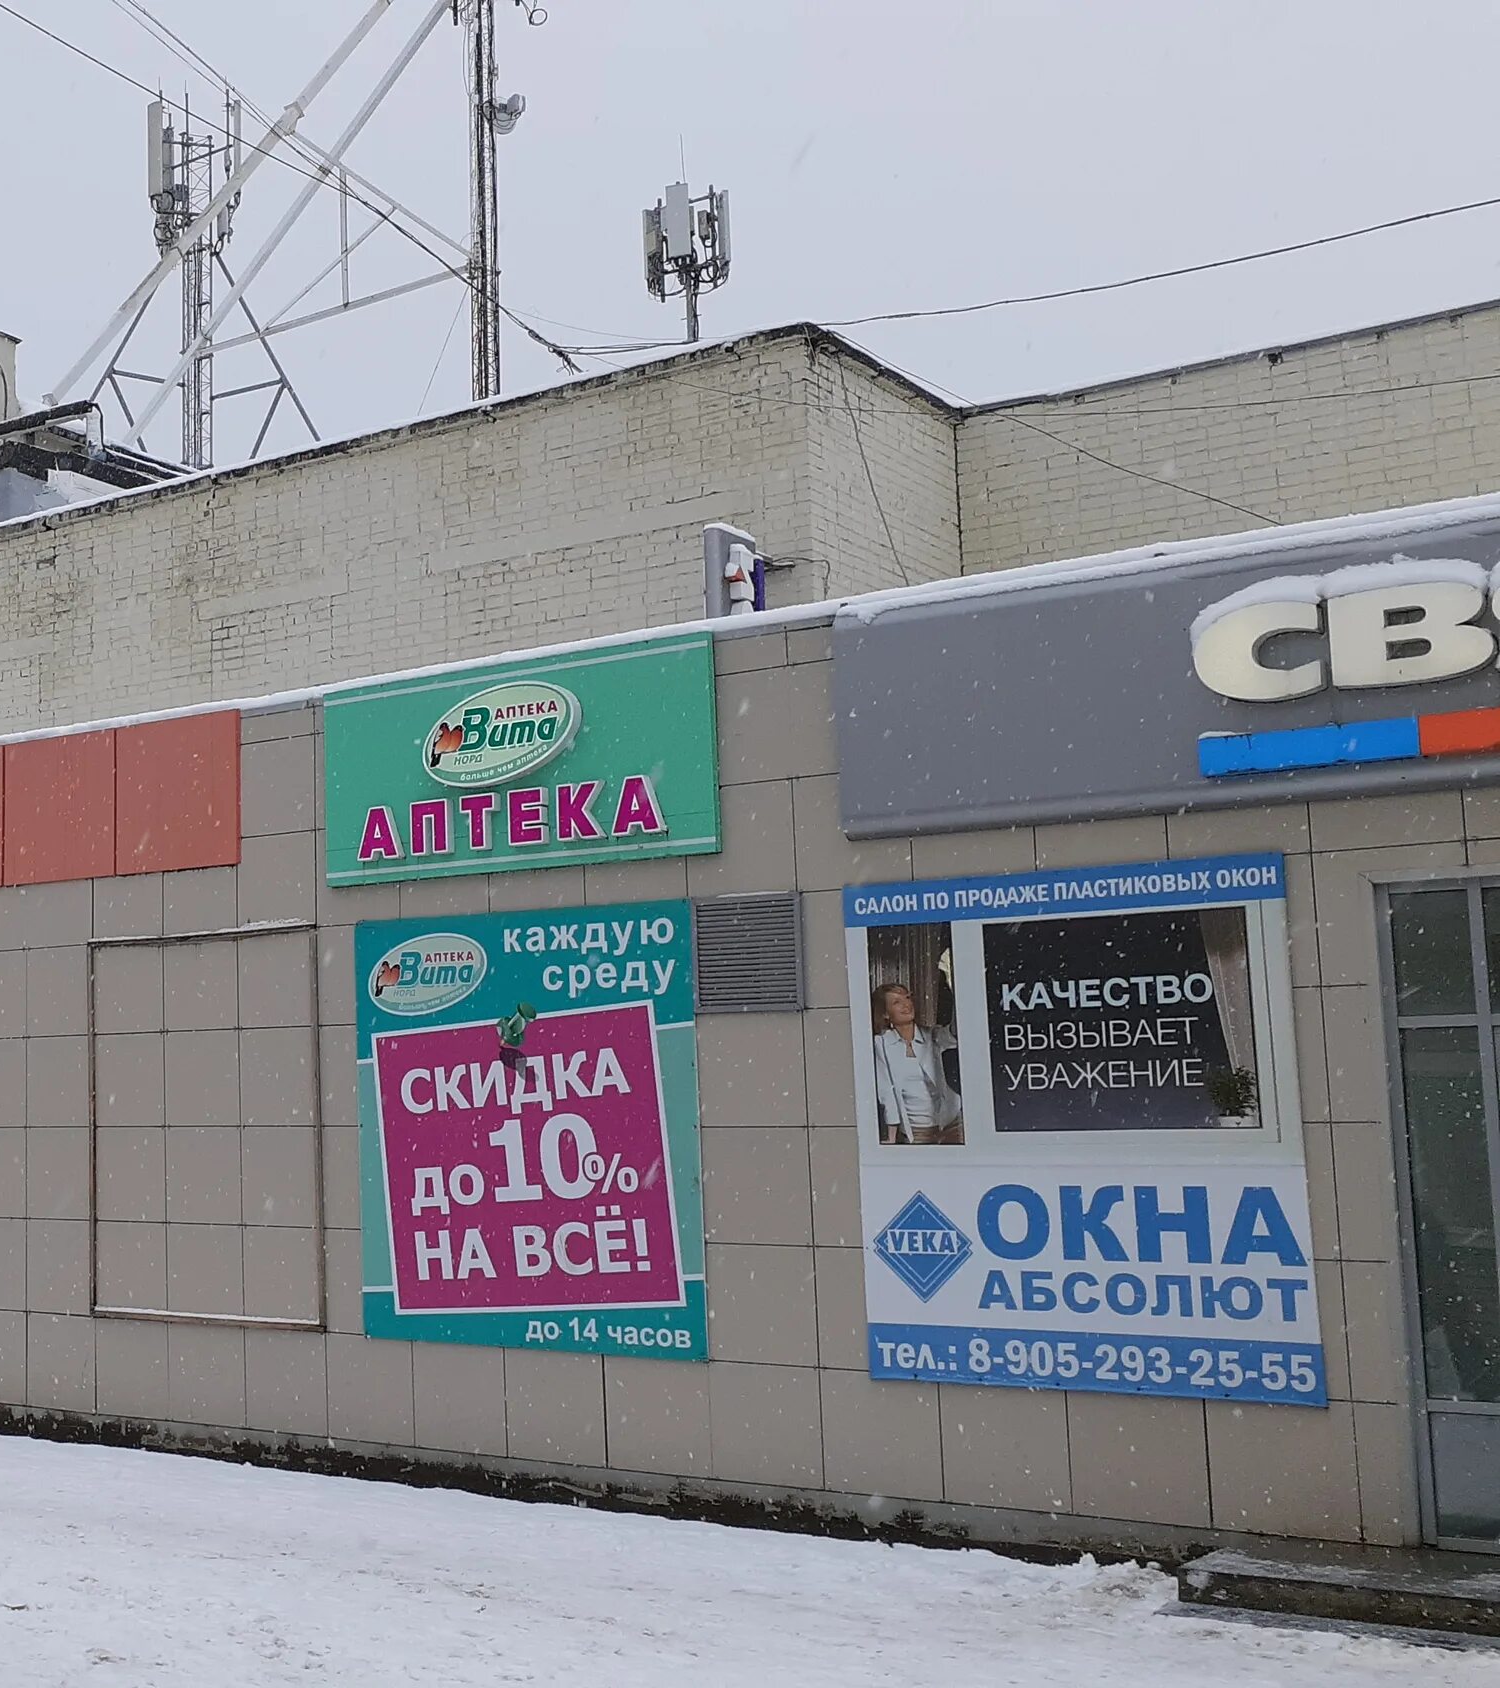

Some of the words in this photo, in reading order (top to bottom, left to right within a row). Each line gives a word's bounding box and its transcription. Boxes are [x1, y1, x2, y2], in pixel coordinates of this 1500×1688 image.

[1192, 580, 1500, 703] СВ
[461, 706, 559, 752] Вита
[493, 699, 559, 722] АПТЕКА
[453, 753, 484, 766] НОРД
[459, 764, 495, 782] больше
[496, 760, 515, 776] чем
[515, 743, 549, 770] аптека
[357, 775, 667, 862] АПТЕКА
[854, 892, 918, 916] САЛОН
[922, 890, 950, 911] ПО
[954, 882, 1050, 910] ПРОДАЖЕ
[1052, 870, 1212, 901] ПЛАСТИКОВЫХ
[1216, 865, 1278, 889] ОКОН
[503, 917, 675, 956] каждую
[399, 951, 474, 987] Вита
[425, 951, 474, 963] АПТЕКА
[542, 959, 676, 997] среду
[1001, 973, 1213, 1012] КАЧЕСТВО
[1003, 1017, 1200, 1053] ВЫЗЫВАЕТ
[400, 1047, 631, 1115] СКИДКА
[1006, 1057, 1205, 1092] УВАЖЕНИЕ
[488, 1113, 639, 1202] 10%
[414, 1229, 497, 1281] НА
[512, 1205, 652, 1279] ВСЁ!
[888, 1229, 958, 1255] VEKA
[975, 1183, 1309, 1268] ОКНА
[977, 1267, 1309, 1322] АБСОЛЮТ
[525, 1319, 559, 1343] до
[568, 1317, 599, 1342] 14
[606, 1325, 691, 1349] часов
[878, 1339, 957, 1373] тел.:
[969, 1338, 1317, 1392] 8-905-293-25-55
